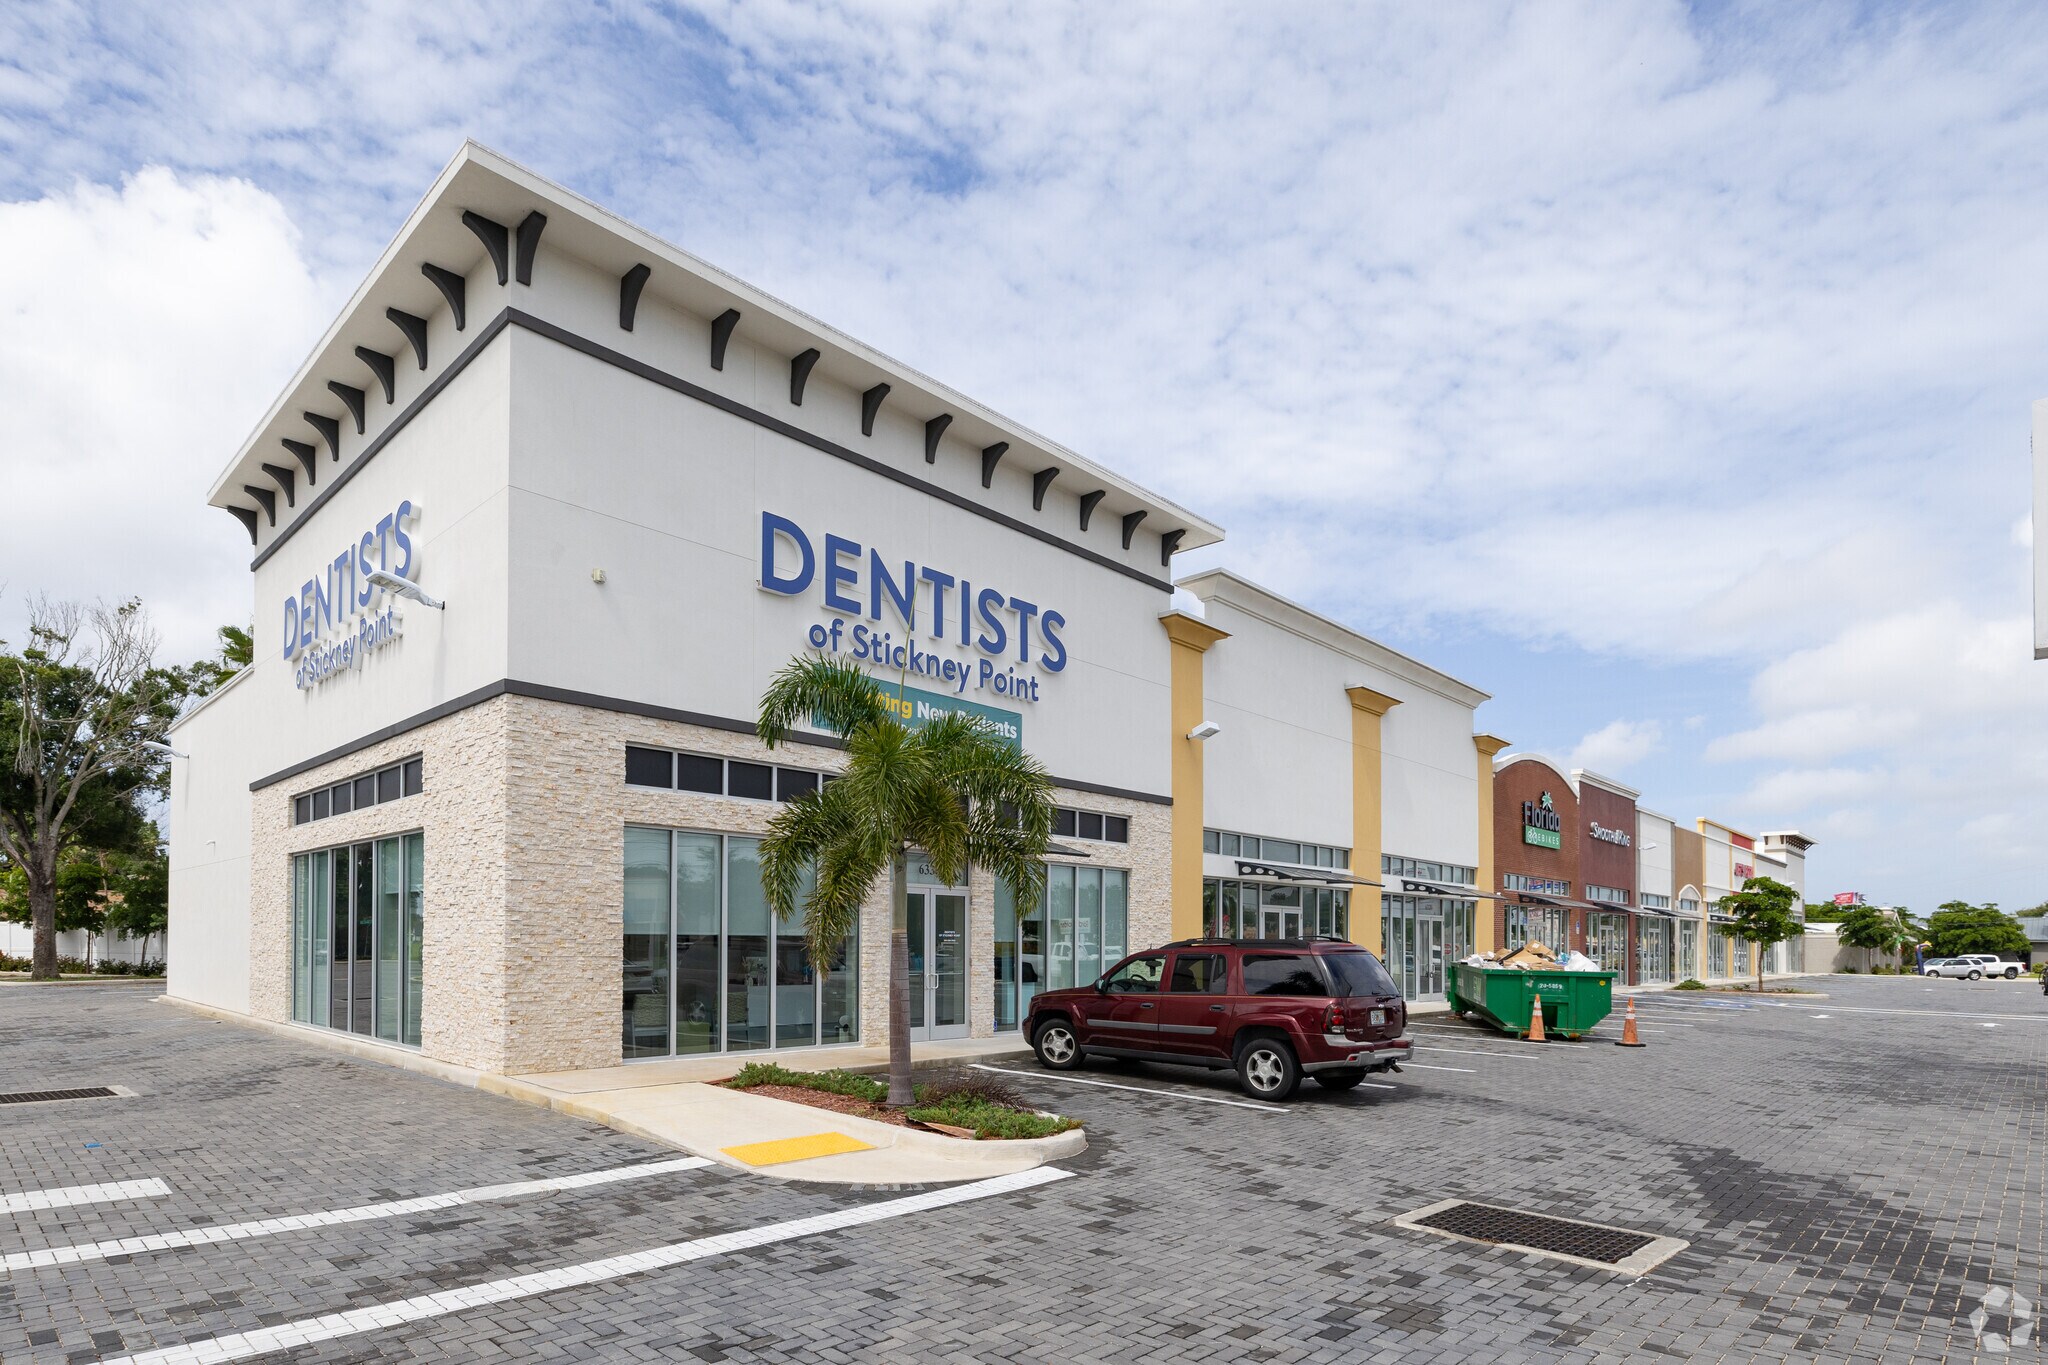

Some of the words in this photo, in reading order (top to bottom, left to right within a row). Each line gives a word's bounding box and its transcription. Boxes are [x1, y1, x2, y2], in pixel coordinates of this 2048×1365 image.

[283, 500, 412, 661] DENTISTS
[761, 510, 1067, 673] DENTISTS
[296, 655, 307, 690] of
[309, 634, 356, 683] Stickney
[360, 604, 394, 652] Point
[808, 618, 845, 652] of
[852, 624, 971, 693] Stickney
[979, 658, 1039, 701] Point
[1524, 800, 1560, 831] Florida
